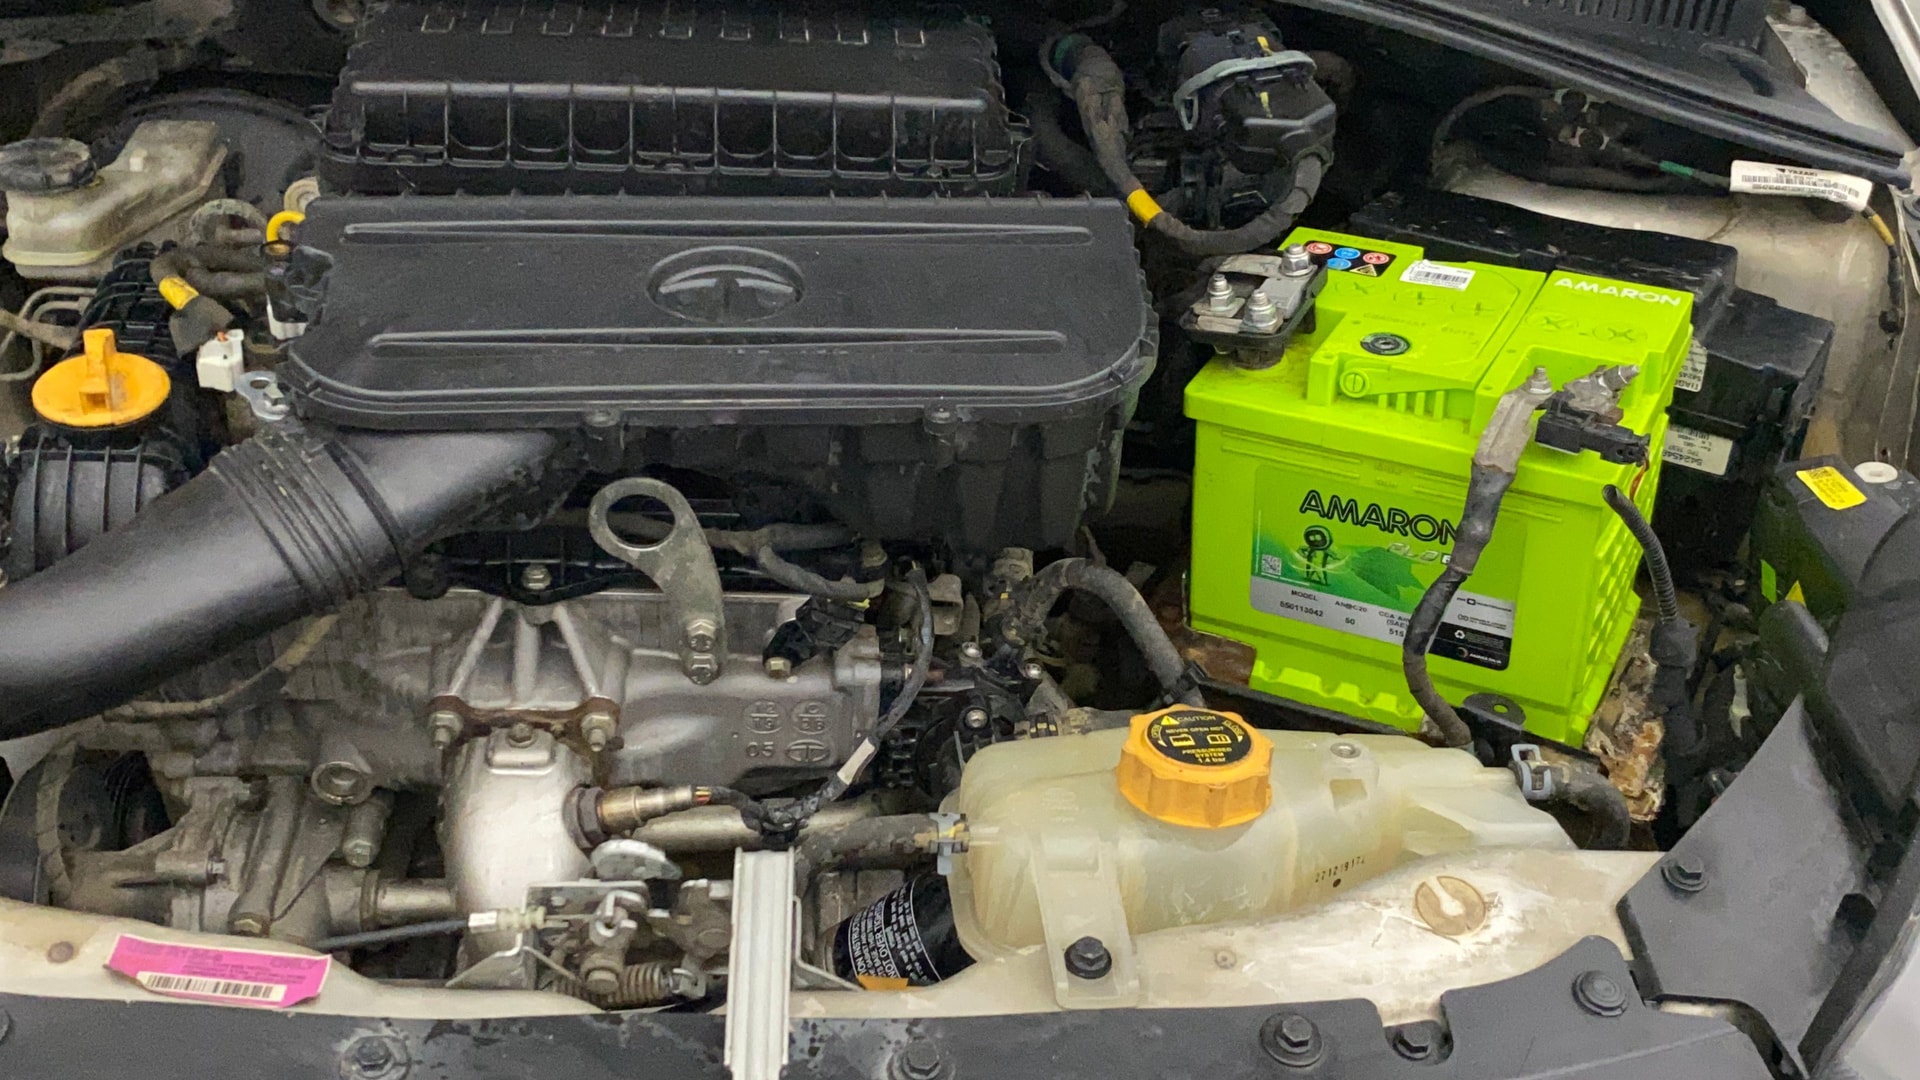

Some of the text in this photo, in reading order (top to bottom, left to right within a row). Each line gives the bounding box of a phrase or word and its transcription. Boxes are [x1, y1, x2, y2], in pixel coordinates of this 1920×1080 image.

[1554, 277, 1681, 306] AMARON
[1290, 589, 1318, 601] MODEL
[1344, 616, 1356, 626] 50
[875, 931, 888, 958] OVER
